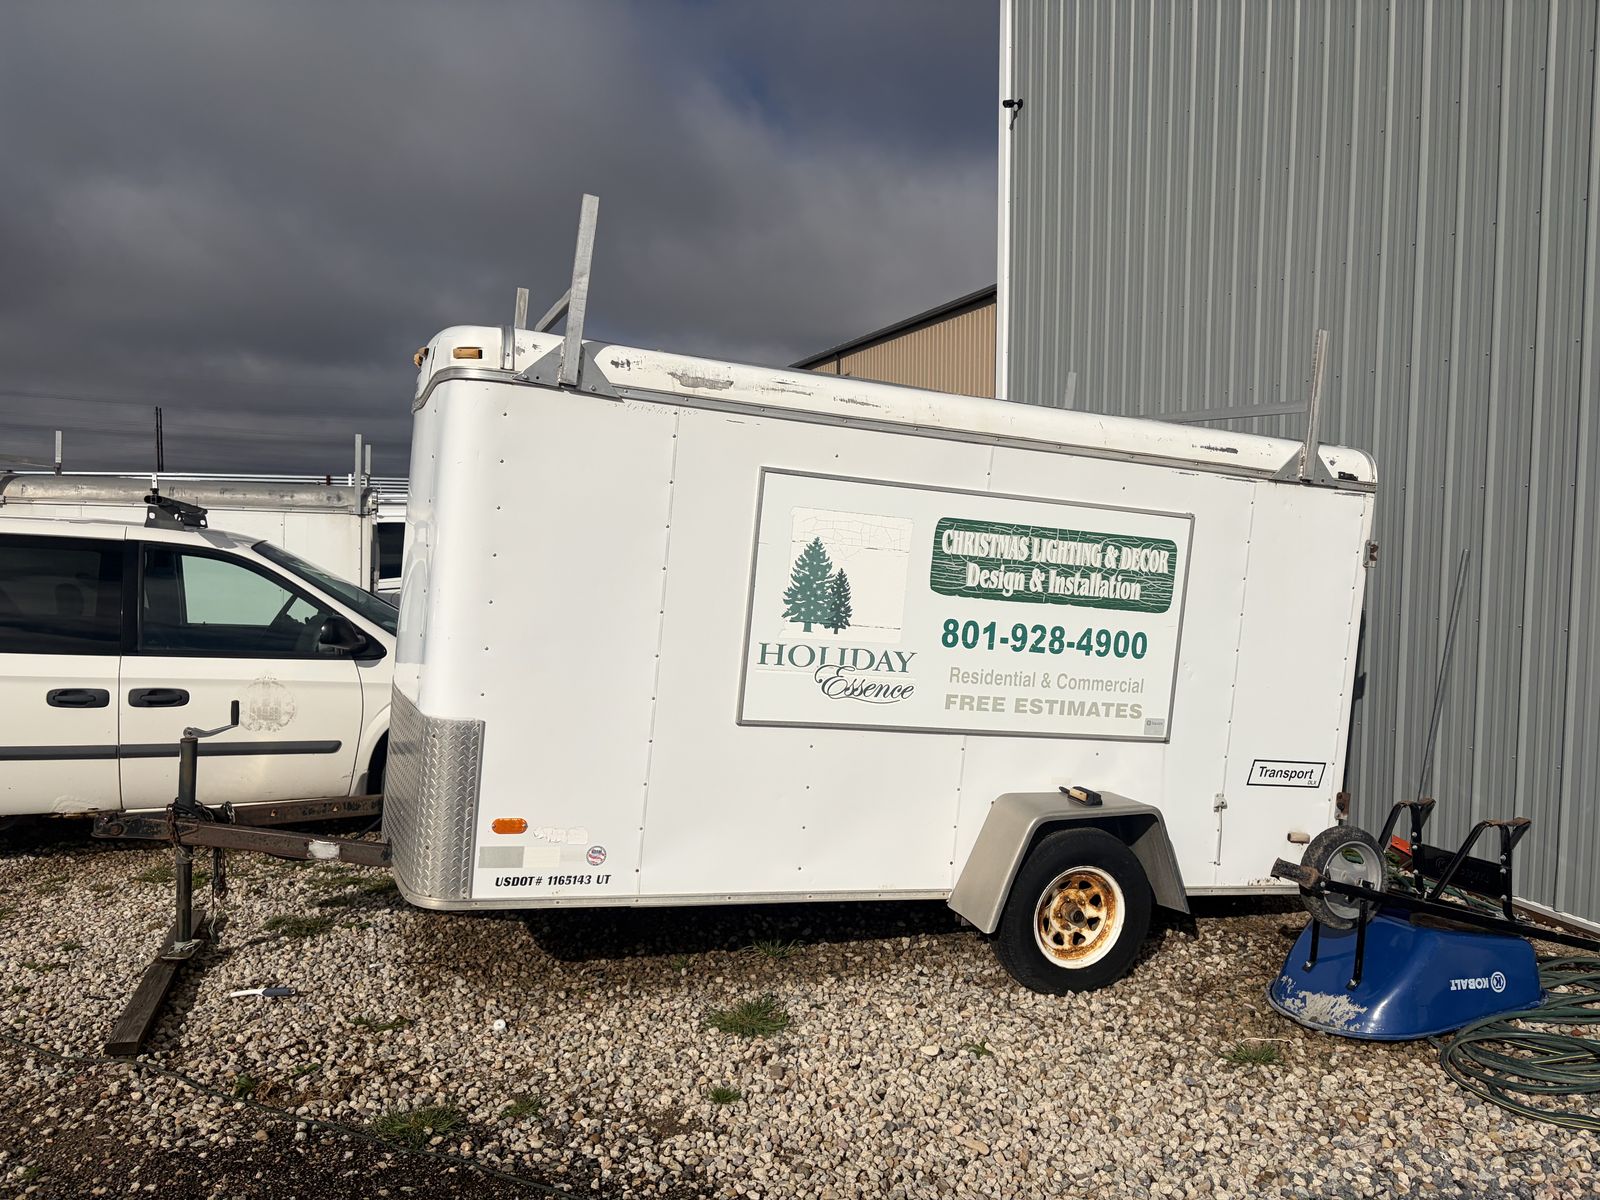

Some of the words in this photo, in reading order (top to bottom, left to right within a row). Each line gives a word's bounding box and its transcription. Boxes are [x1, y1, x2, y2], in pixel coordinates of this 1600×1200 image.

[942, 529, 1030, 561] CHRISTMAS
[1031, 538, 1102, 567] LIGHTING
[1104, 545, 1119, 569] &
[1119, 547, 1170, 574] DECOR
[966, 562, 1025, 597] Design
[1029, 568, 1045, 593] &
[1048, 569, 1141, 600] Installation
[941, 618, 1148, 660] 801-928-4900
[756, 642, 918, 673] HOLIDAY
[814, 664, 915, 704] Essence
[949, 667, 1036, 688] Residential
[1040, 672, 1052, 689] &
[1056, 673, 1145, 694] Commercial
[944, 693, 1006, 713] FREE
[1014, 697, 1143, 720] ESTIMATES
[1259, 766, 1314, 781] Transport
[495, 876, 543, 887] USDOT#
[547, 875, 592, 886] 1165143
[596, 874, 612, 885] UT
[1450, 977, 1489, 991] KOBALT
